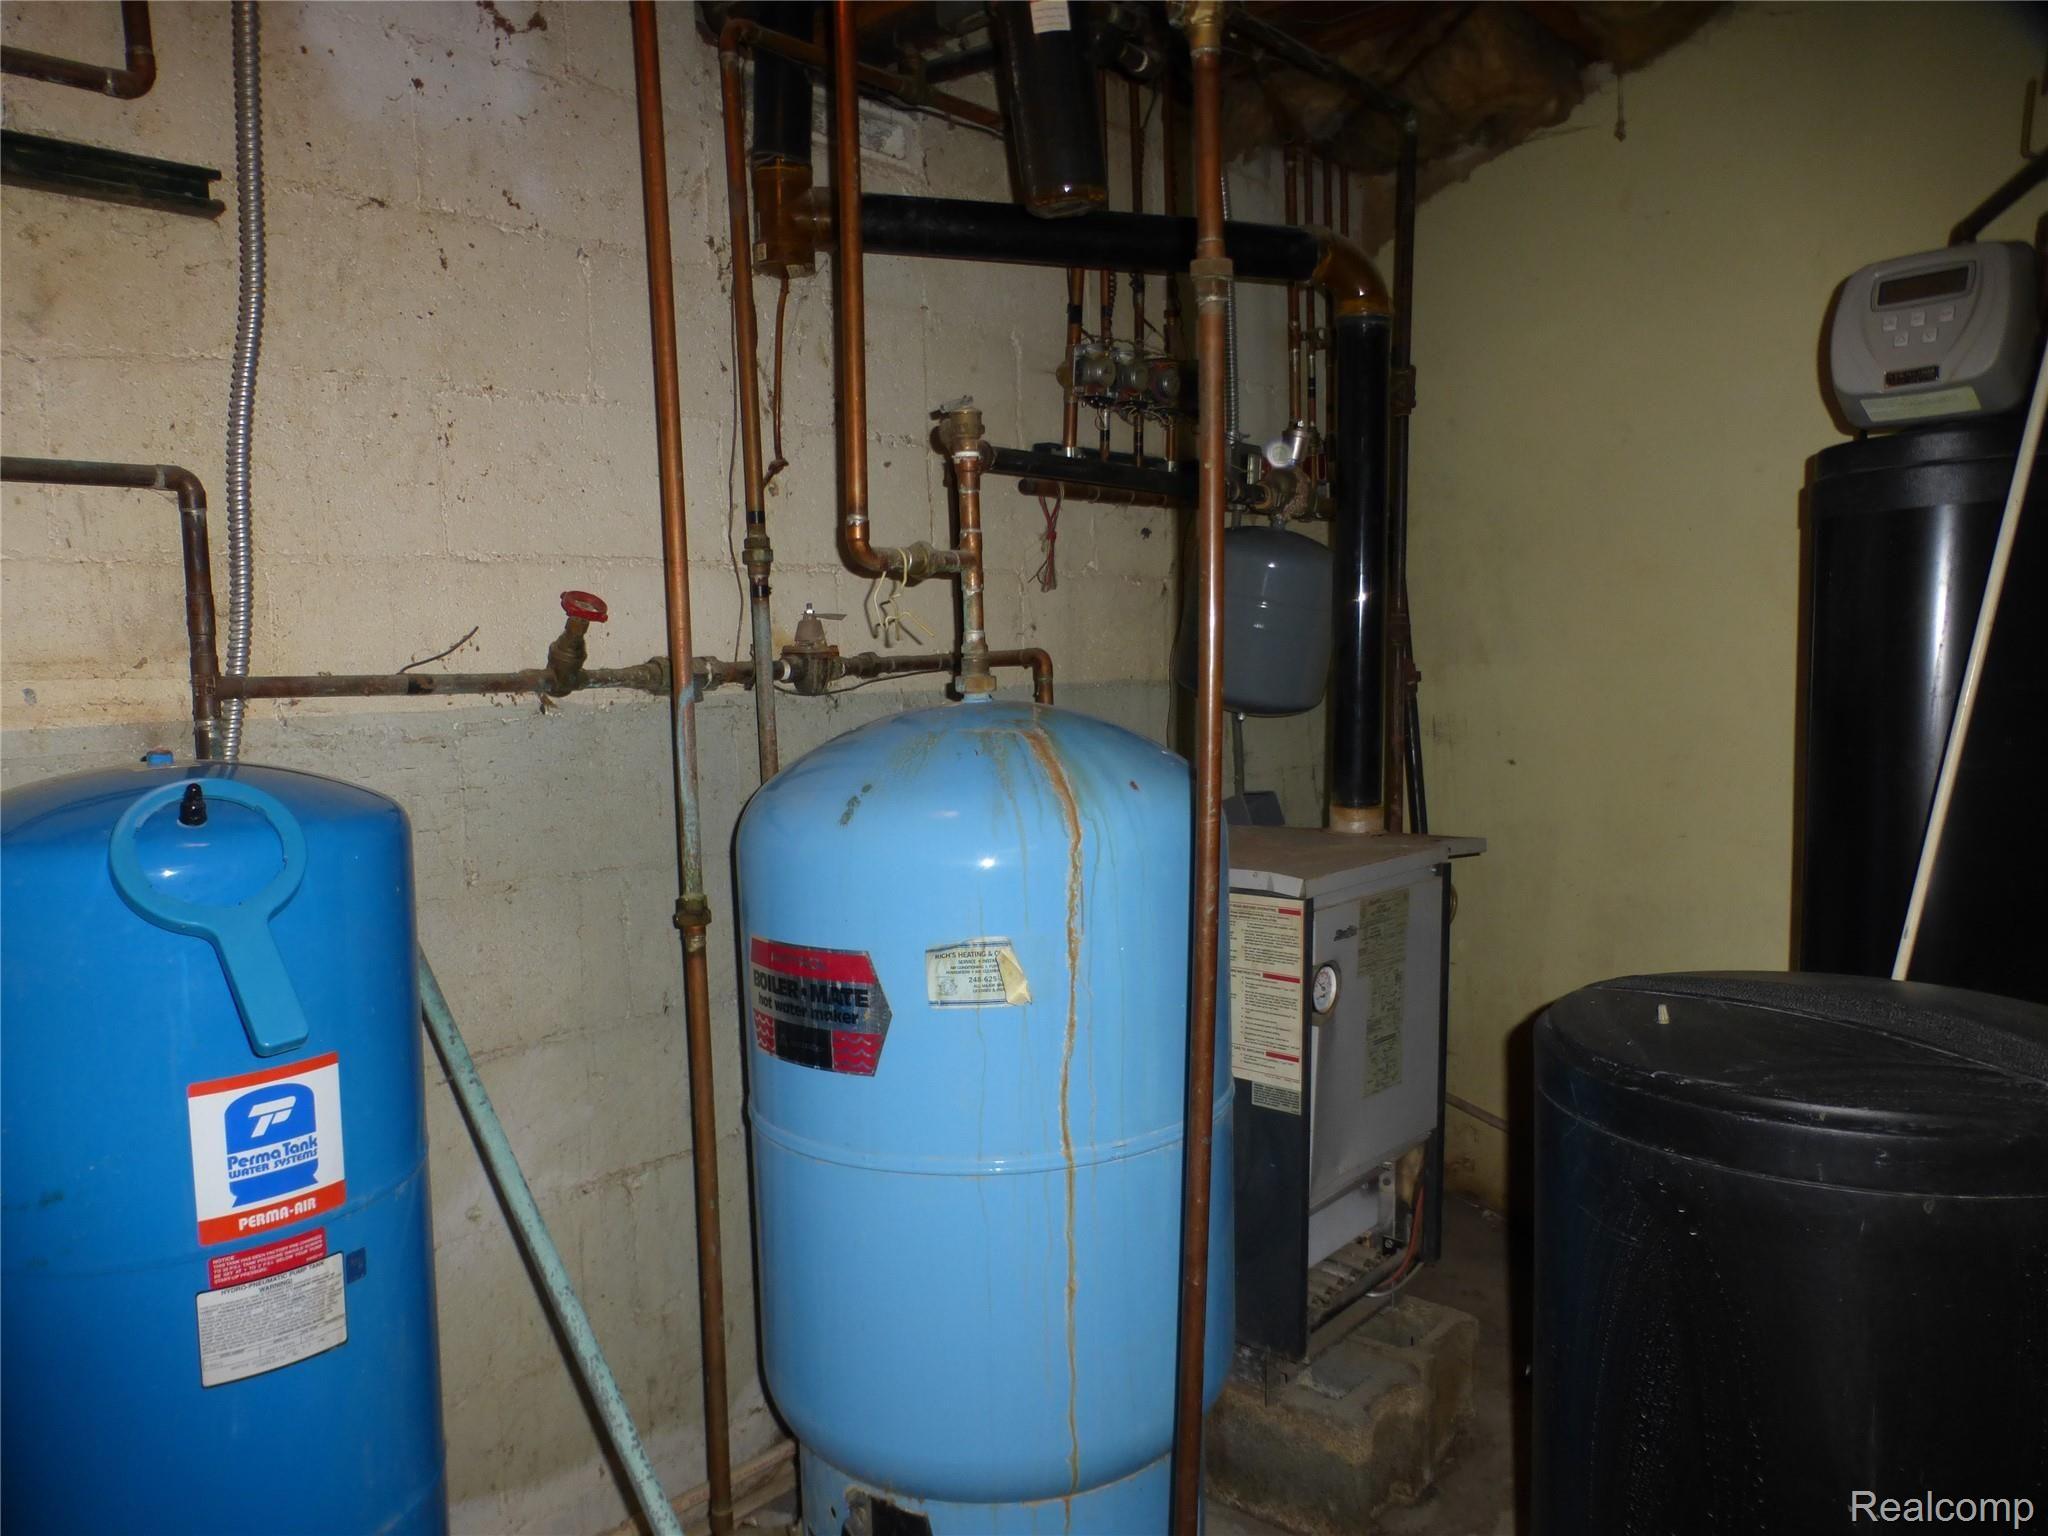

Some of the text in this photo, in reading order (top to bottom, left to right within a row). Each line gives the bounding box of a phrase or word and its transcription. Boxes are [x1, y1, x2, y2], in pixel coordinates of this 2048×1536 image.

[753, 969, 869, 1008] BOILER MATE
[759, 992, 859, 1024] hot water maker
[227, 1135, 318, 1171] Perma Tank
[229, 1148, 318, 1179] WATER SYSTEMS
[238, 1197, 317, 1231] PERMA-AIR
